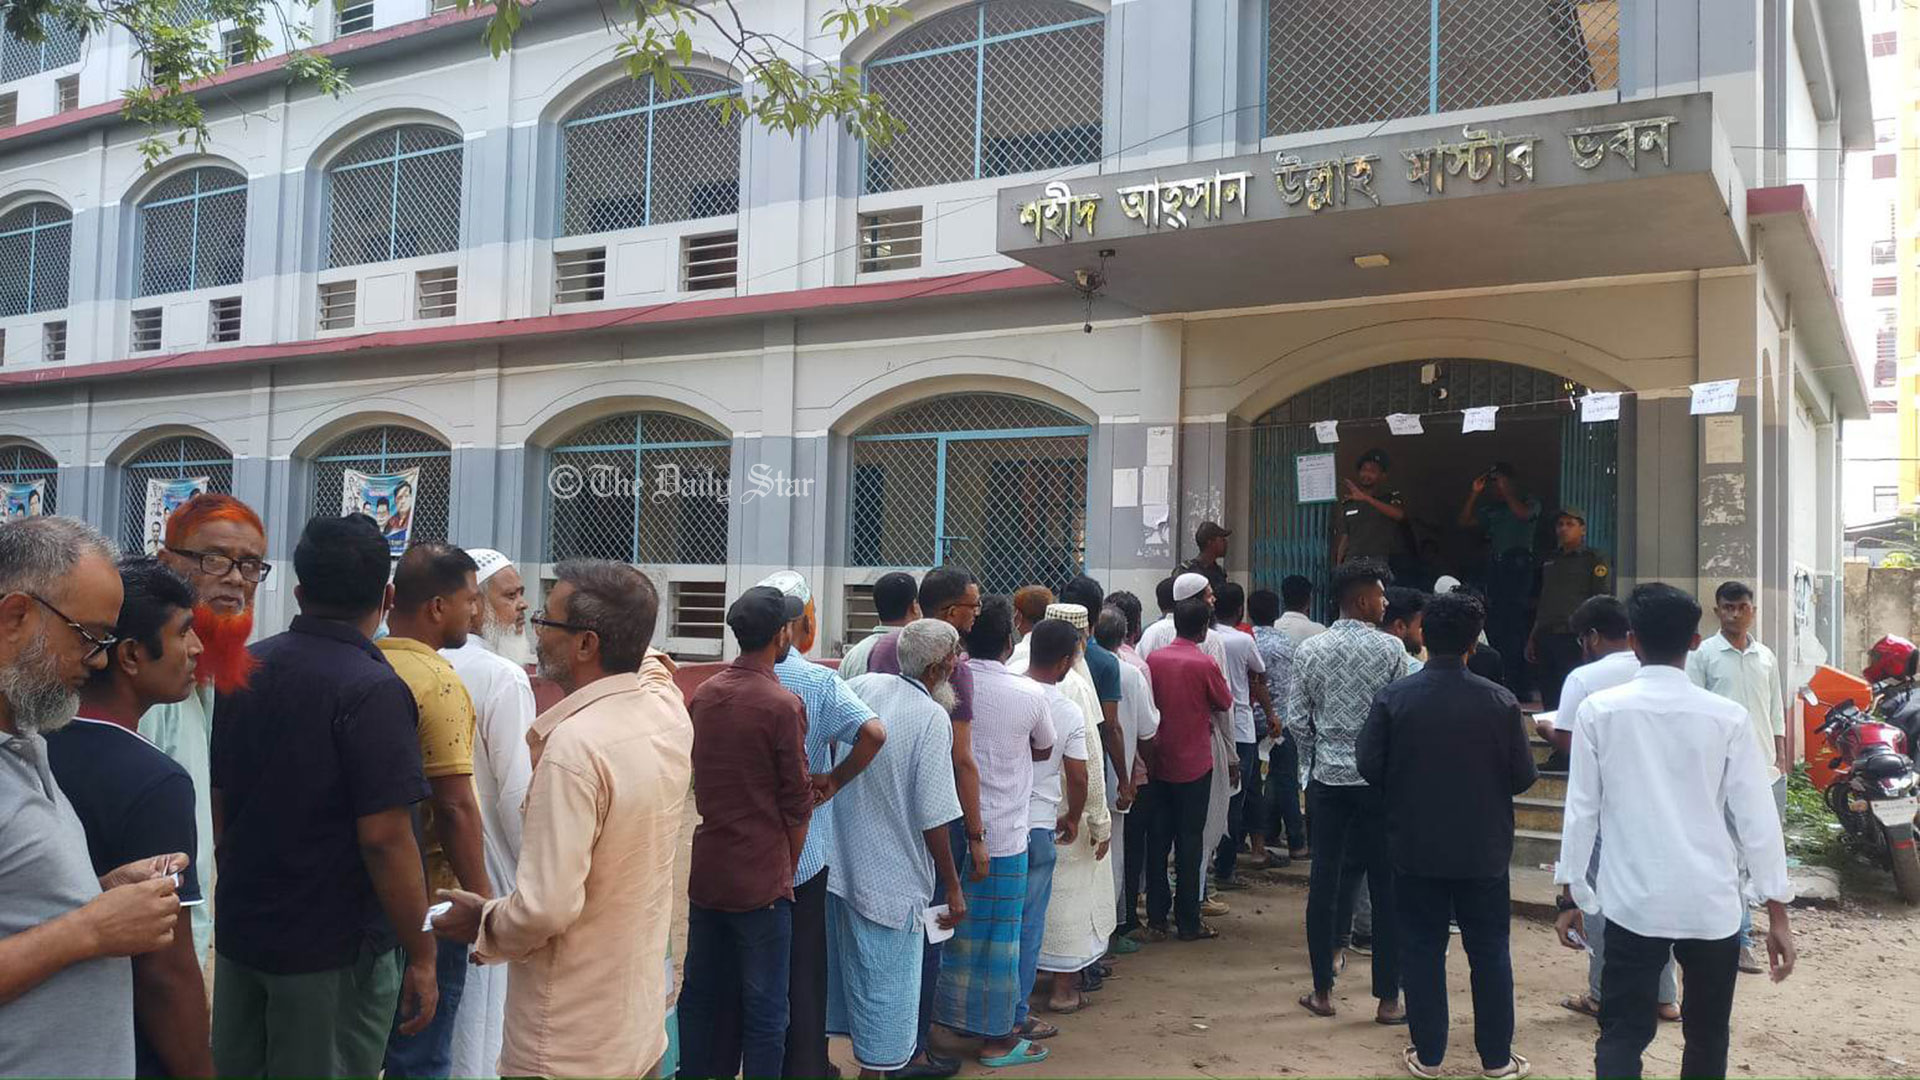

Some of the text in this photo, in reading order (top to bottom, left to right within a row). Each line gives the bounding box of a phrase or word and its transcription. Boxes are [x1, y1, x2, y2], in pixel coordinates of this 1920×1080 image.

[1019, 180, 1103, 243] শহীদ
[1398, 124, 1543, 194] মাস্টার
[1565, 115, 1680, 171] ভবন
